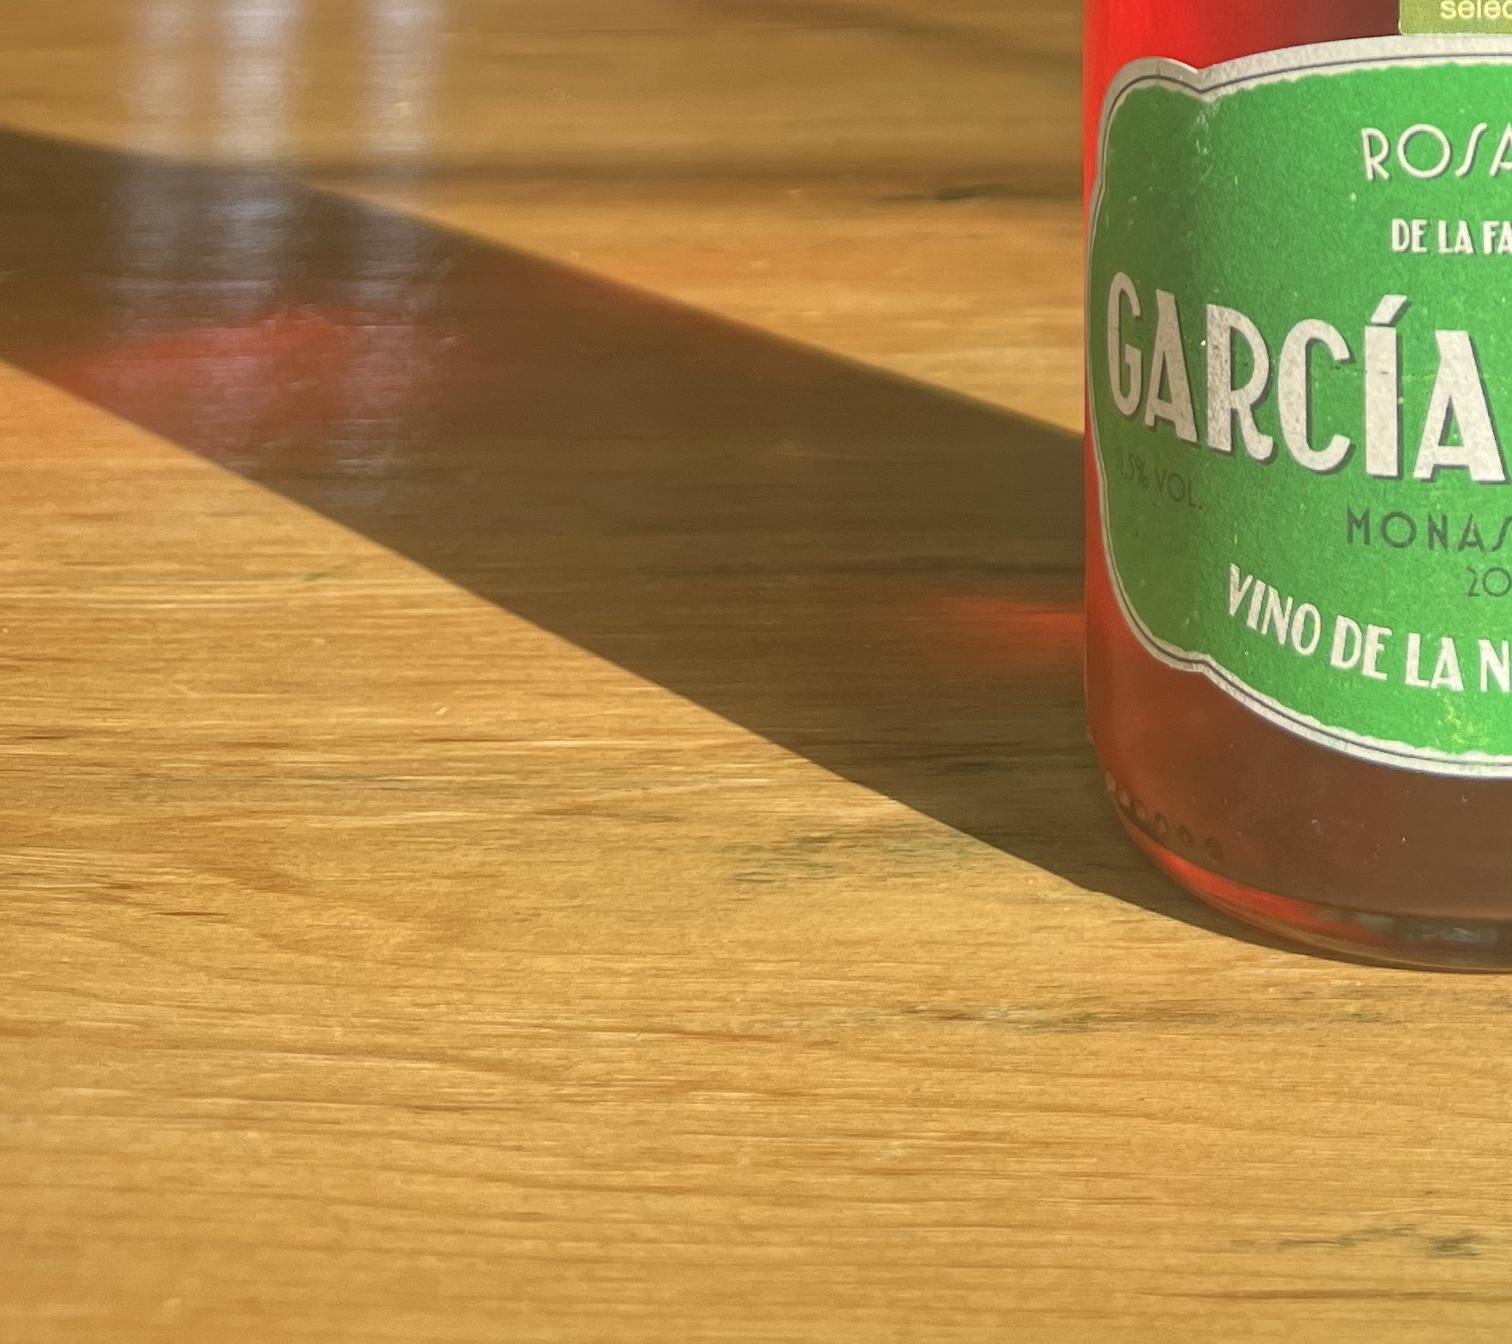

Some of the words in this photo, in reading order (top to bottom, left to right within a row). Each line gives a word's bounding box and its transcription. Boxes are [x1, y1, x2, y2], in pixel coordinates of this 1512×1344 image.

[1391, 217, 1429, 254] DE
[1437, 219, 1475, 256] LA
[1106, 269, 1509, 484] GARCÍA
[1154, 465, 1204, 510] VOL.
[1227, 562, 1323, 657] VINO
[1330, 613, 1393, 682] DE
[1404, 631, 1466, 692] LA
